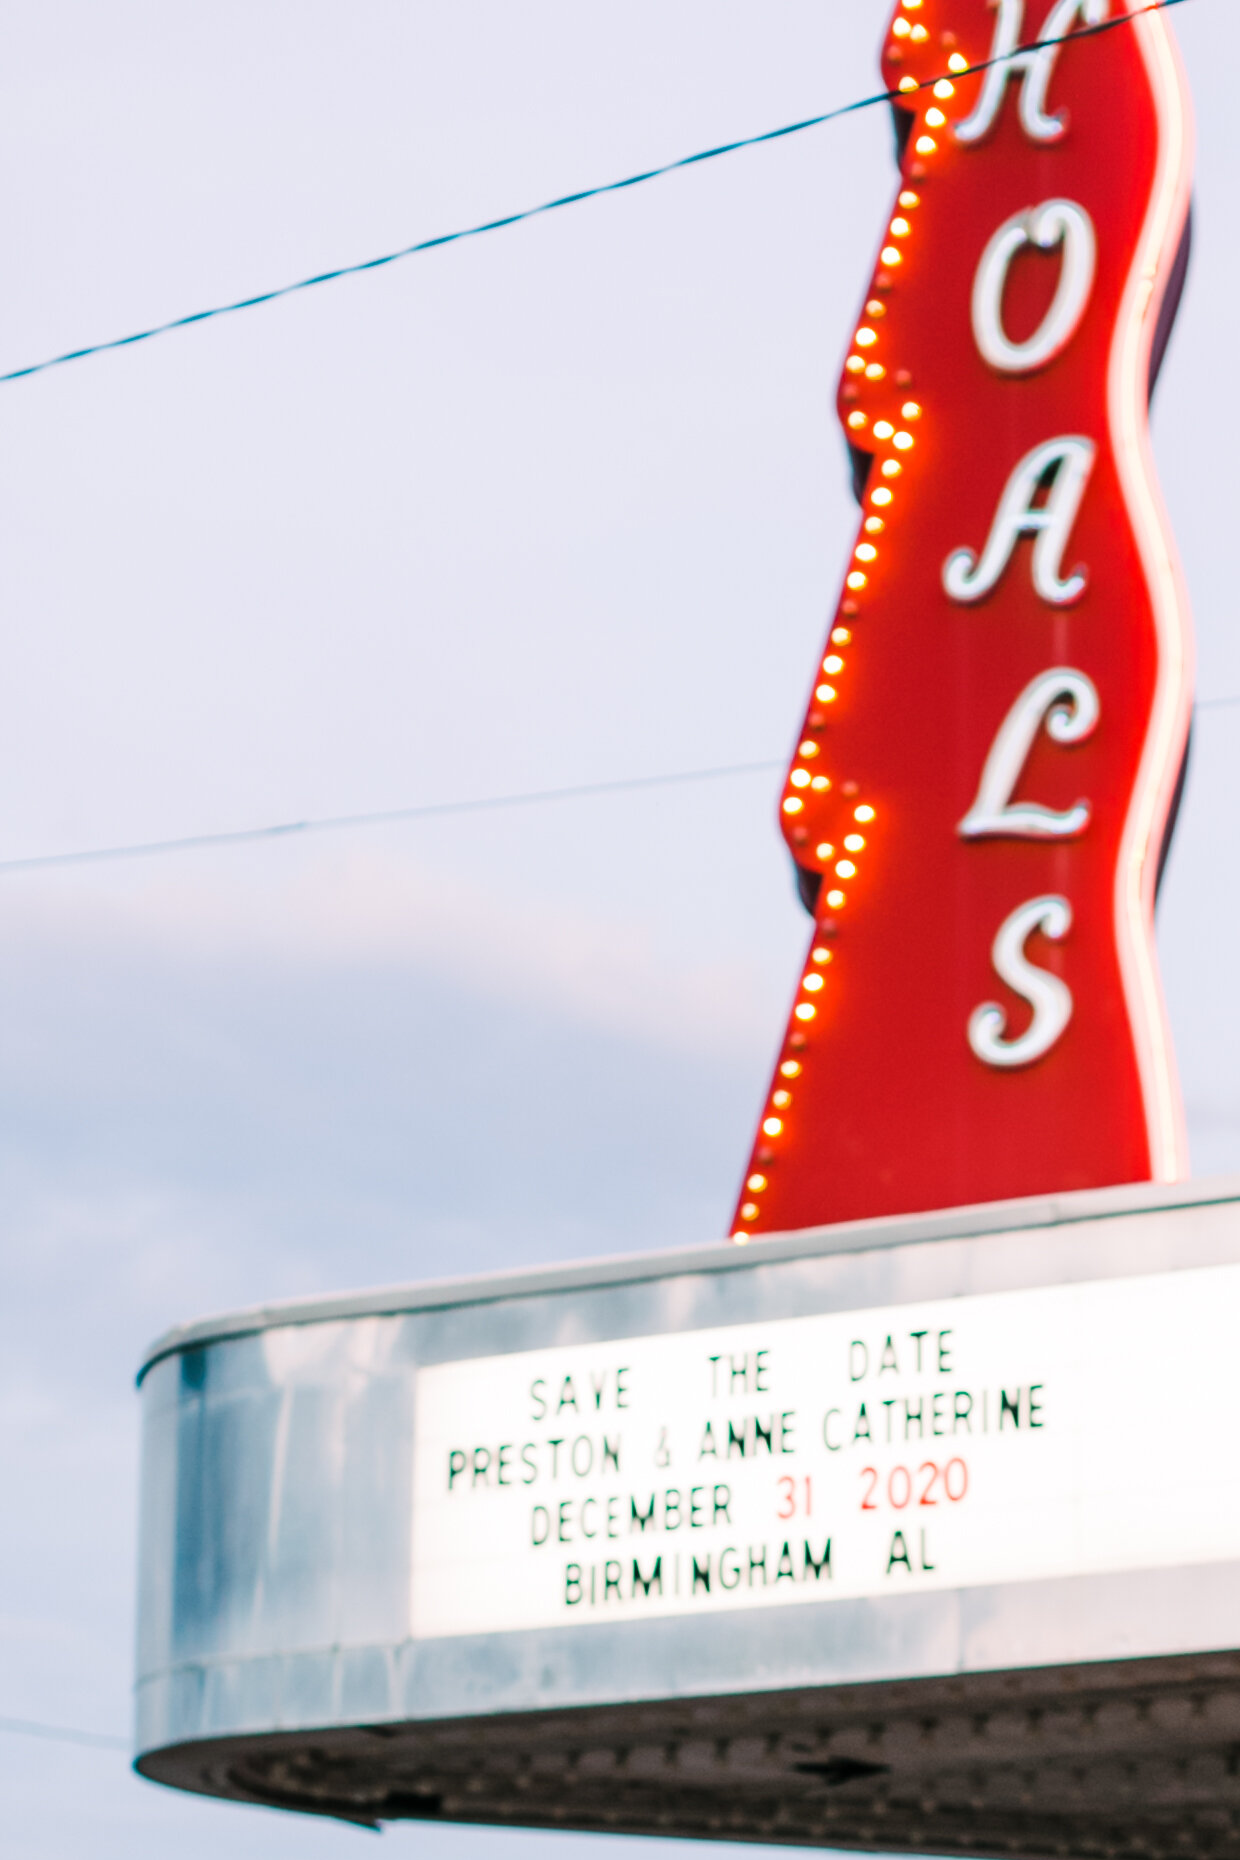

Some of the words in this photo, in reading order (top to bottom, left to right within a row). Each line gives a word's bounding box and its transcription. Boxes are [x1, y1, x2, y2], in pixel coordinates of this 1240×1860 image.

[530, 1367, 630, 1422] SAVE
[708, 1350, 771, 1400] THE
[849, 1329, 953, 1383] DATE
[447, 1433, 621, 1491] PRESTON
[653, 1426, 672, 1469] &
[699, 1411, 796, 1460] ANNE
[822, 1384, 1045, 1452] CATHERINE
[531, 1484, 733, 1548] DECEMBER
[776, 1475, 812, 1520] 31
[859, 1456, 969, 1512] 2020
[564, 1537, 833, 1606] BIRMINGHAM
[885, 1528, 936, 1577] AL
